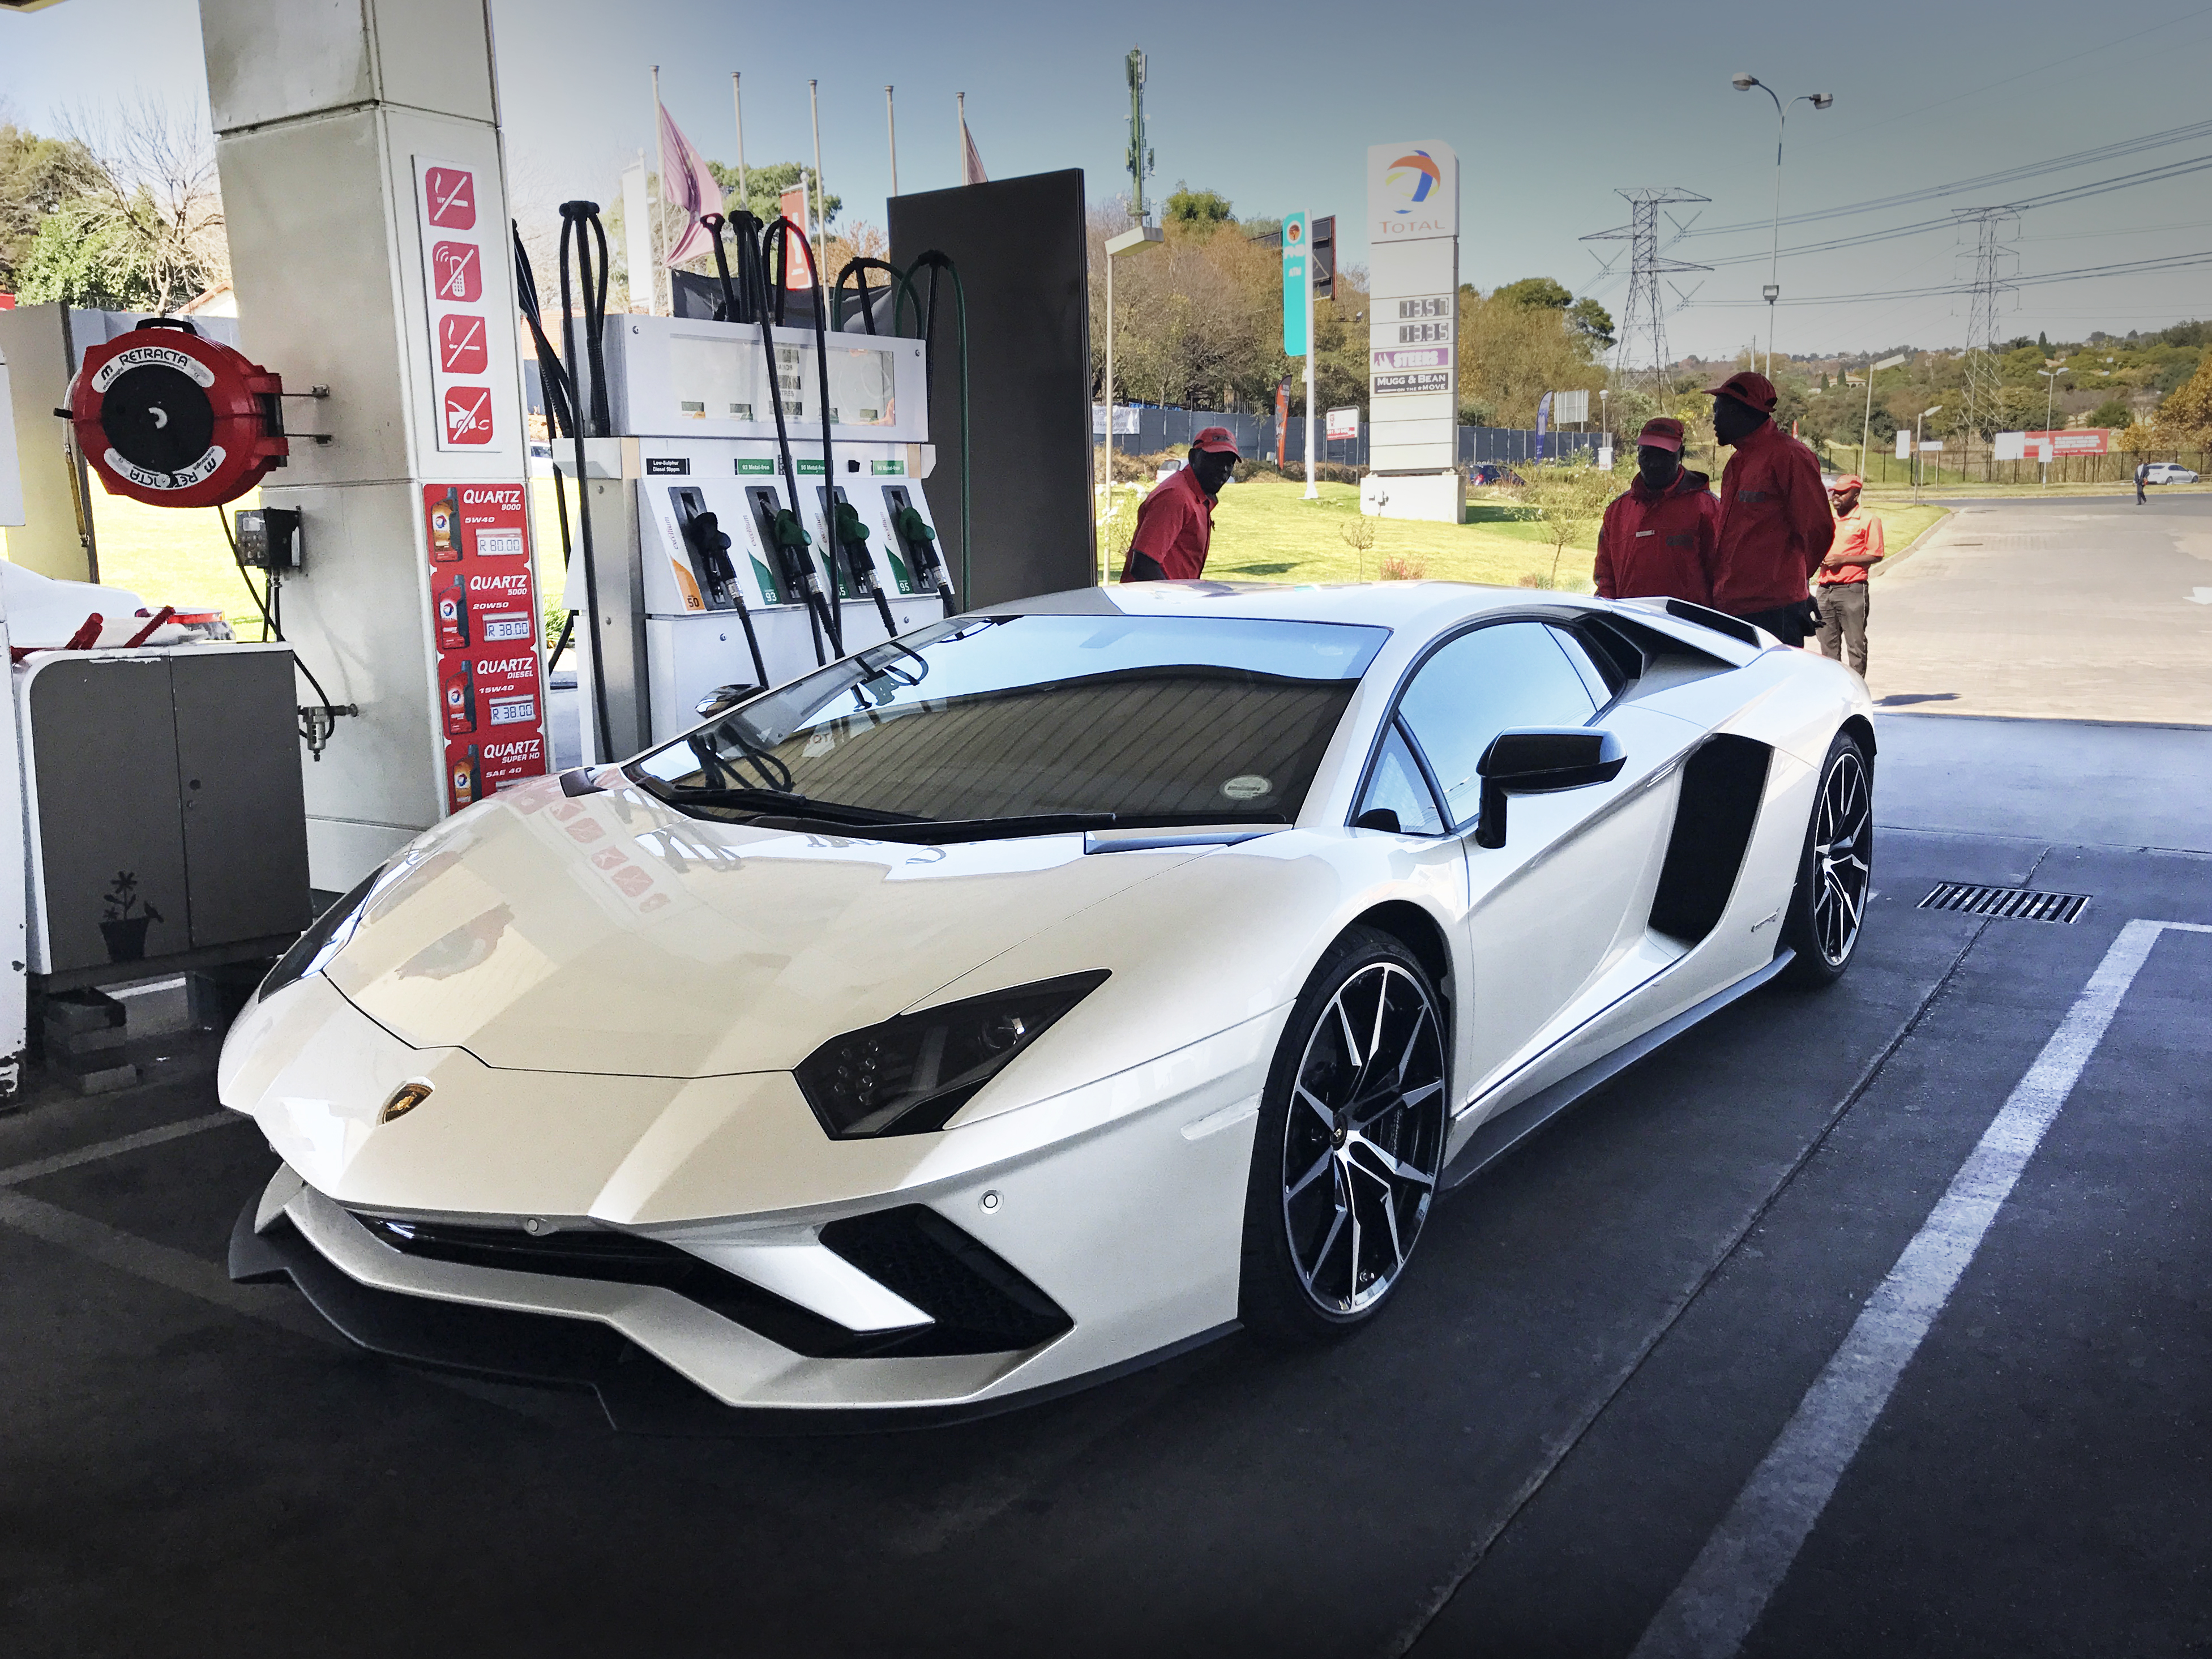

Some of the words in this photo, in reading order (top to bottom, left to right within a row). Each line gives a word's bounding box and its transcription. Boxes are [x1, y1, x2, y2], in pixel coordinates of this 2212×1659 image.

[1379, 220, 1445, 234] TOTAL
[1406, 298, 1448, 317] 13.57
[1406, 323, 1448, 342] 13.35
[118, 348, 189, 366] RETRACTA
[1393, 350, 1439, 368] STEERS
[1377, 377, 1406, 386] MUGG
[1407, 375, 1416, 384] &
[1418, 374, 1446, 383] BEAN
[463, 489, 521, 504] QUARTZ
[480, 540, 486, 551] R
[490, 539, 520, 551] 80.00
[470, 575, 527, 590] QUARTZ
[900, 582, 910, 592] 95
[687, 597, 700, 608] 50
[765, 592, 777, 602] 93
[472, 601, 509, 610] 20W50
[489, 624, 495, 636] R
[499, 622, 528, 636] 38.00
[477, 657, 533, 674] QUARTZ
[507, 670, 533, 679] DIESEL
[479, 685, 514, 694] 15W40
[493, 708, 499, 720] R
[503, 704, 533, 718] 38.00
[484, 739, 540, 759] QUARTZ
[502, 754, 527, 763] SUPER
[485, 769, 506, 778] SAE
